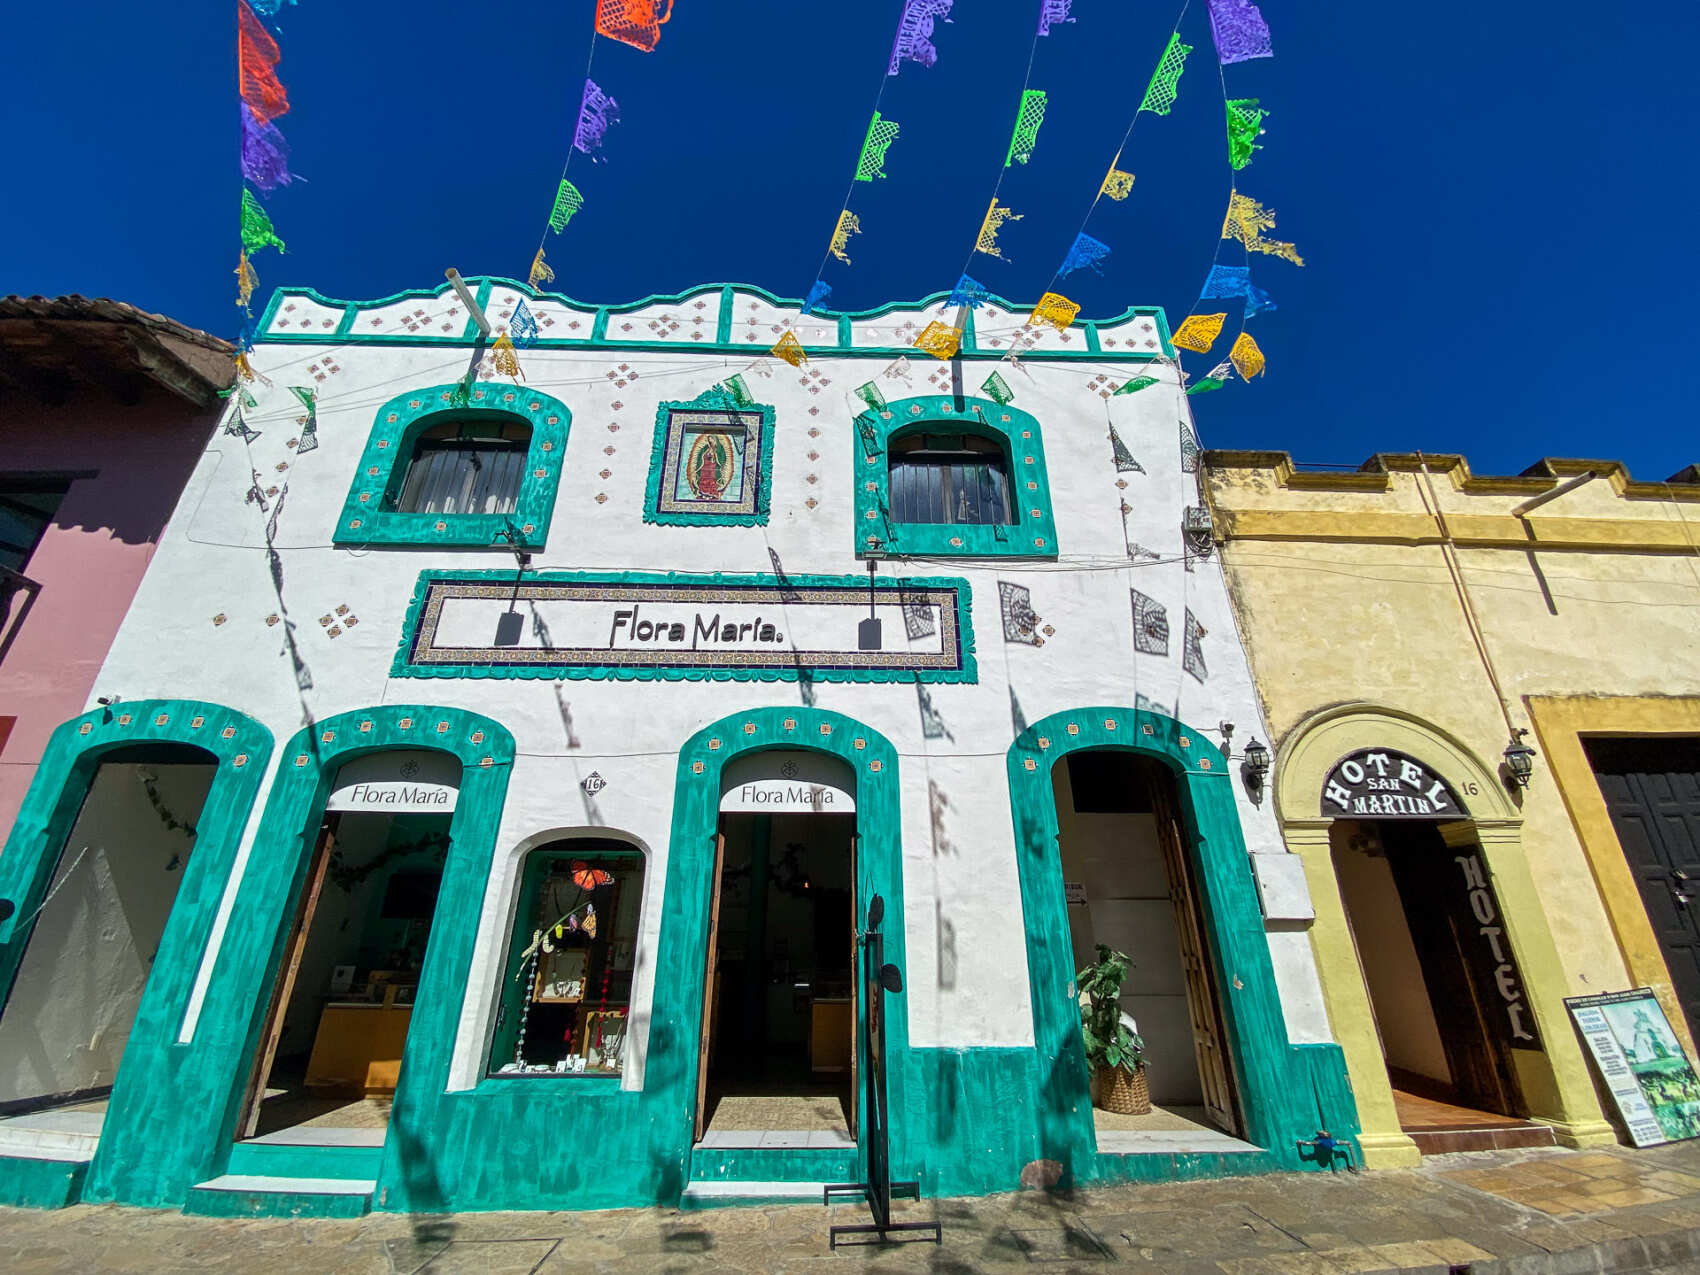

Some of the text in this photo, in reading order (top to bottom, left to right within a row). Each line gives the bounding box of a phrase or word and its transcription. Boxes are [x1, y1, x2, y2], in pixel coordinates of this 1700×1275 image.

[609, 604, 686, 649] Flora
[588, 778, 600, 790] 16
[1325, 753, 1448, 811] HOTEL
[1366, 777, 1401, 791] SAN
[1462, 781, 1478, 796] 16
[351, 785, 448, 804] Flora María
[741, 785, 834, 804] Flora María
[1353, 793, 1431, 815] MARTIN
[1455, 855, 1534, 1041] HOTEL
